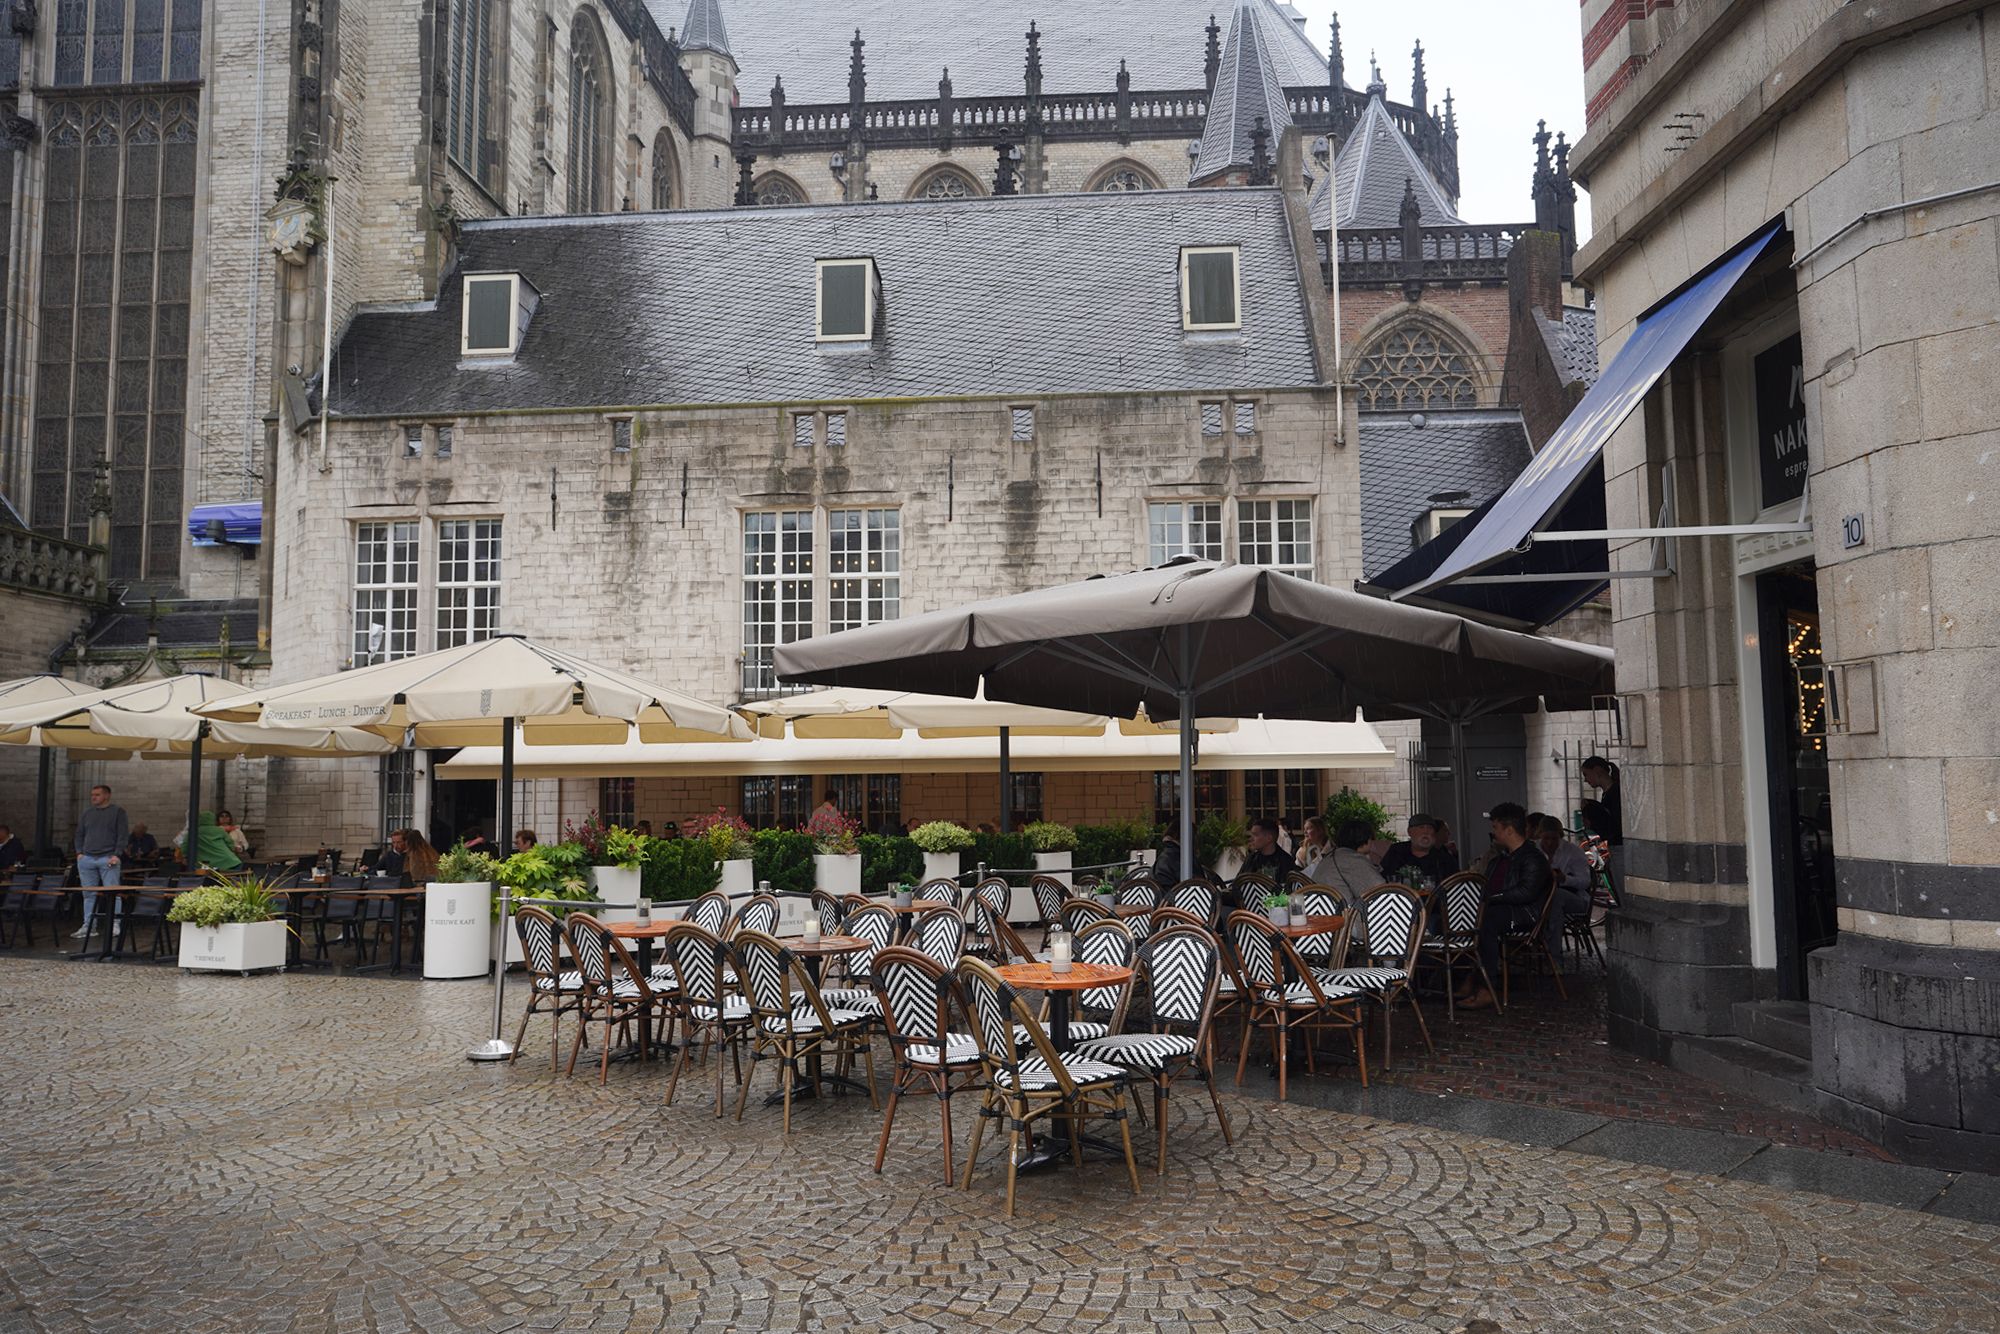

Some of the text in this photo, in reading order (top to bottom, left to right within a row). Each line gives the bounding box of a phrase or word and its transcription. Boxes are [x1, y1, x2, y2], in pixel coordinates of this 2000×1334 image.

[1843, 517, 1861, 544] 10
[318, 706, 346, 718] LUNCH
[353, 704, 387, 717] DINNER
